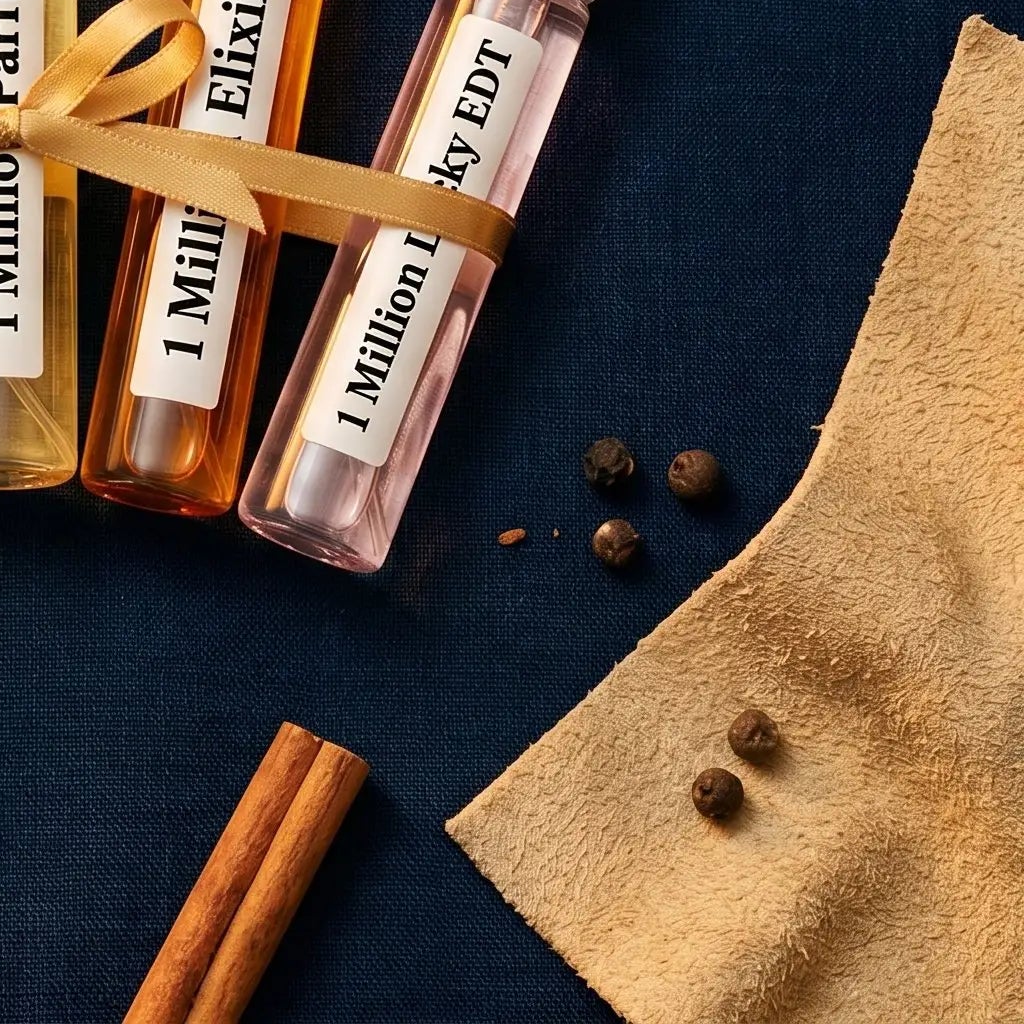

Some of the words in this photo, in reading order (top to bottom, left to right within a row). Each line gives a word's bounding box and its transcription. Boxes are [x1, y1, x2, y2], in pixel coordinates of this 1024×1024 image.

[452, 38, 512, 130] EDT
[403, 131, 481, 258] Lky
[162, 339, 204, 361] 1
[344, 263, 430, 406] Million
[337, 410, 371, 433] 1
